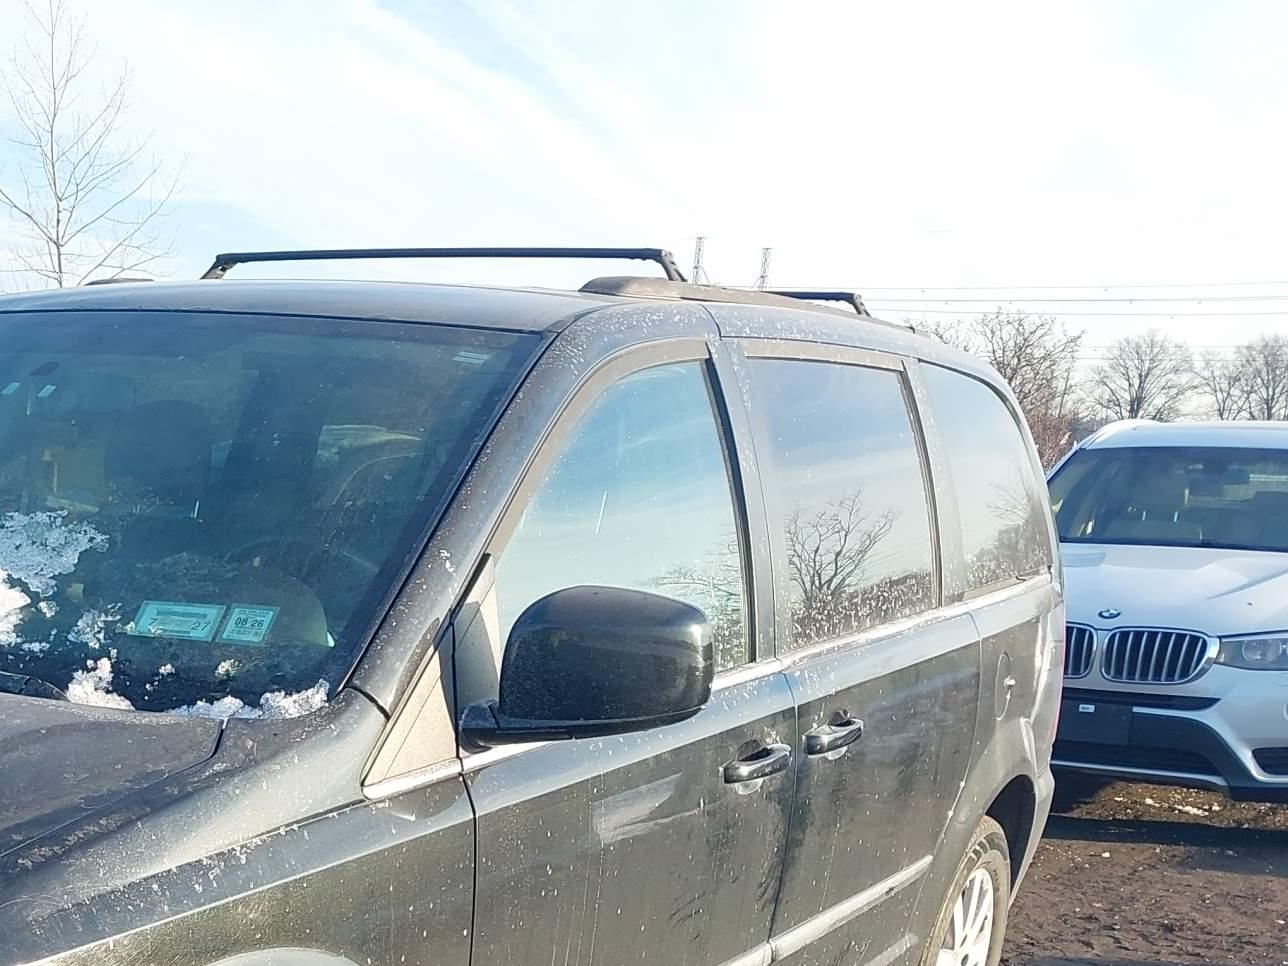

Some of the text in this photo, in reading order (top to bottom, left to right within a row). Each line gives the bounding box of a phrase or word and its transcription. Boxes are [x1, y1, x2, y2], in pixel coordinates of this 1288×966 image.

[190, 620, 211, 632] 27
[234, 616, 265, 628] 08 26
